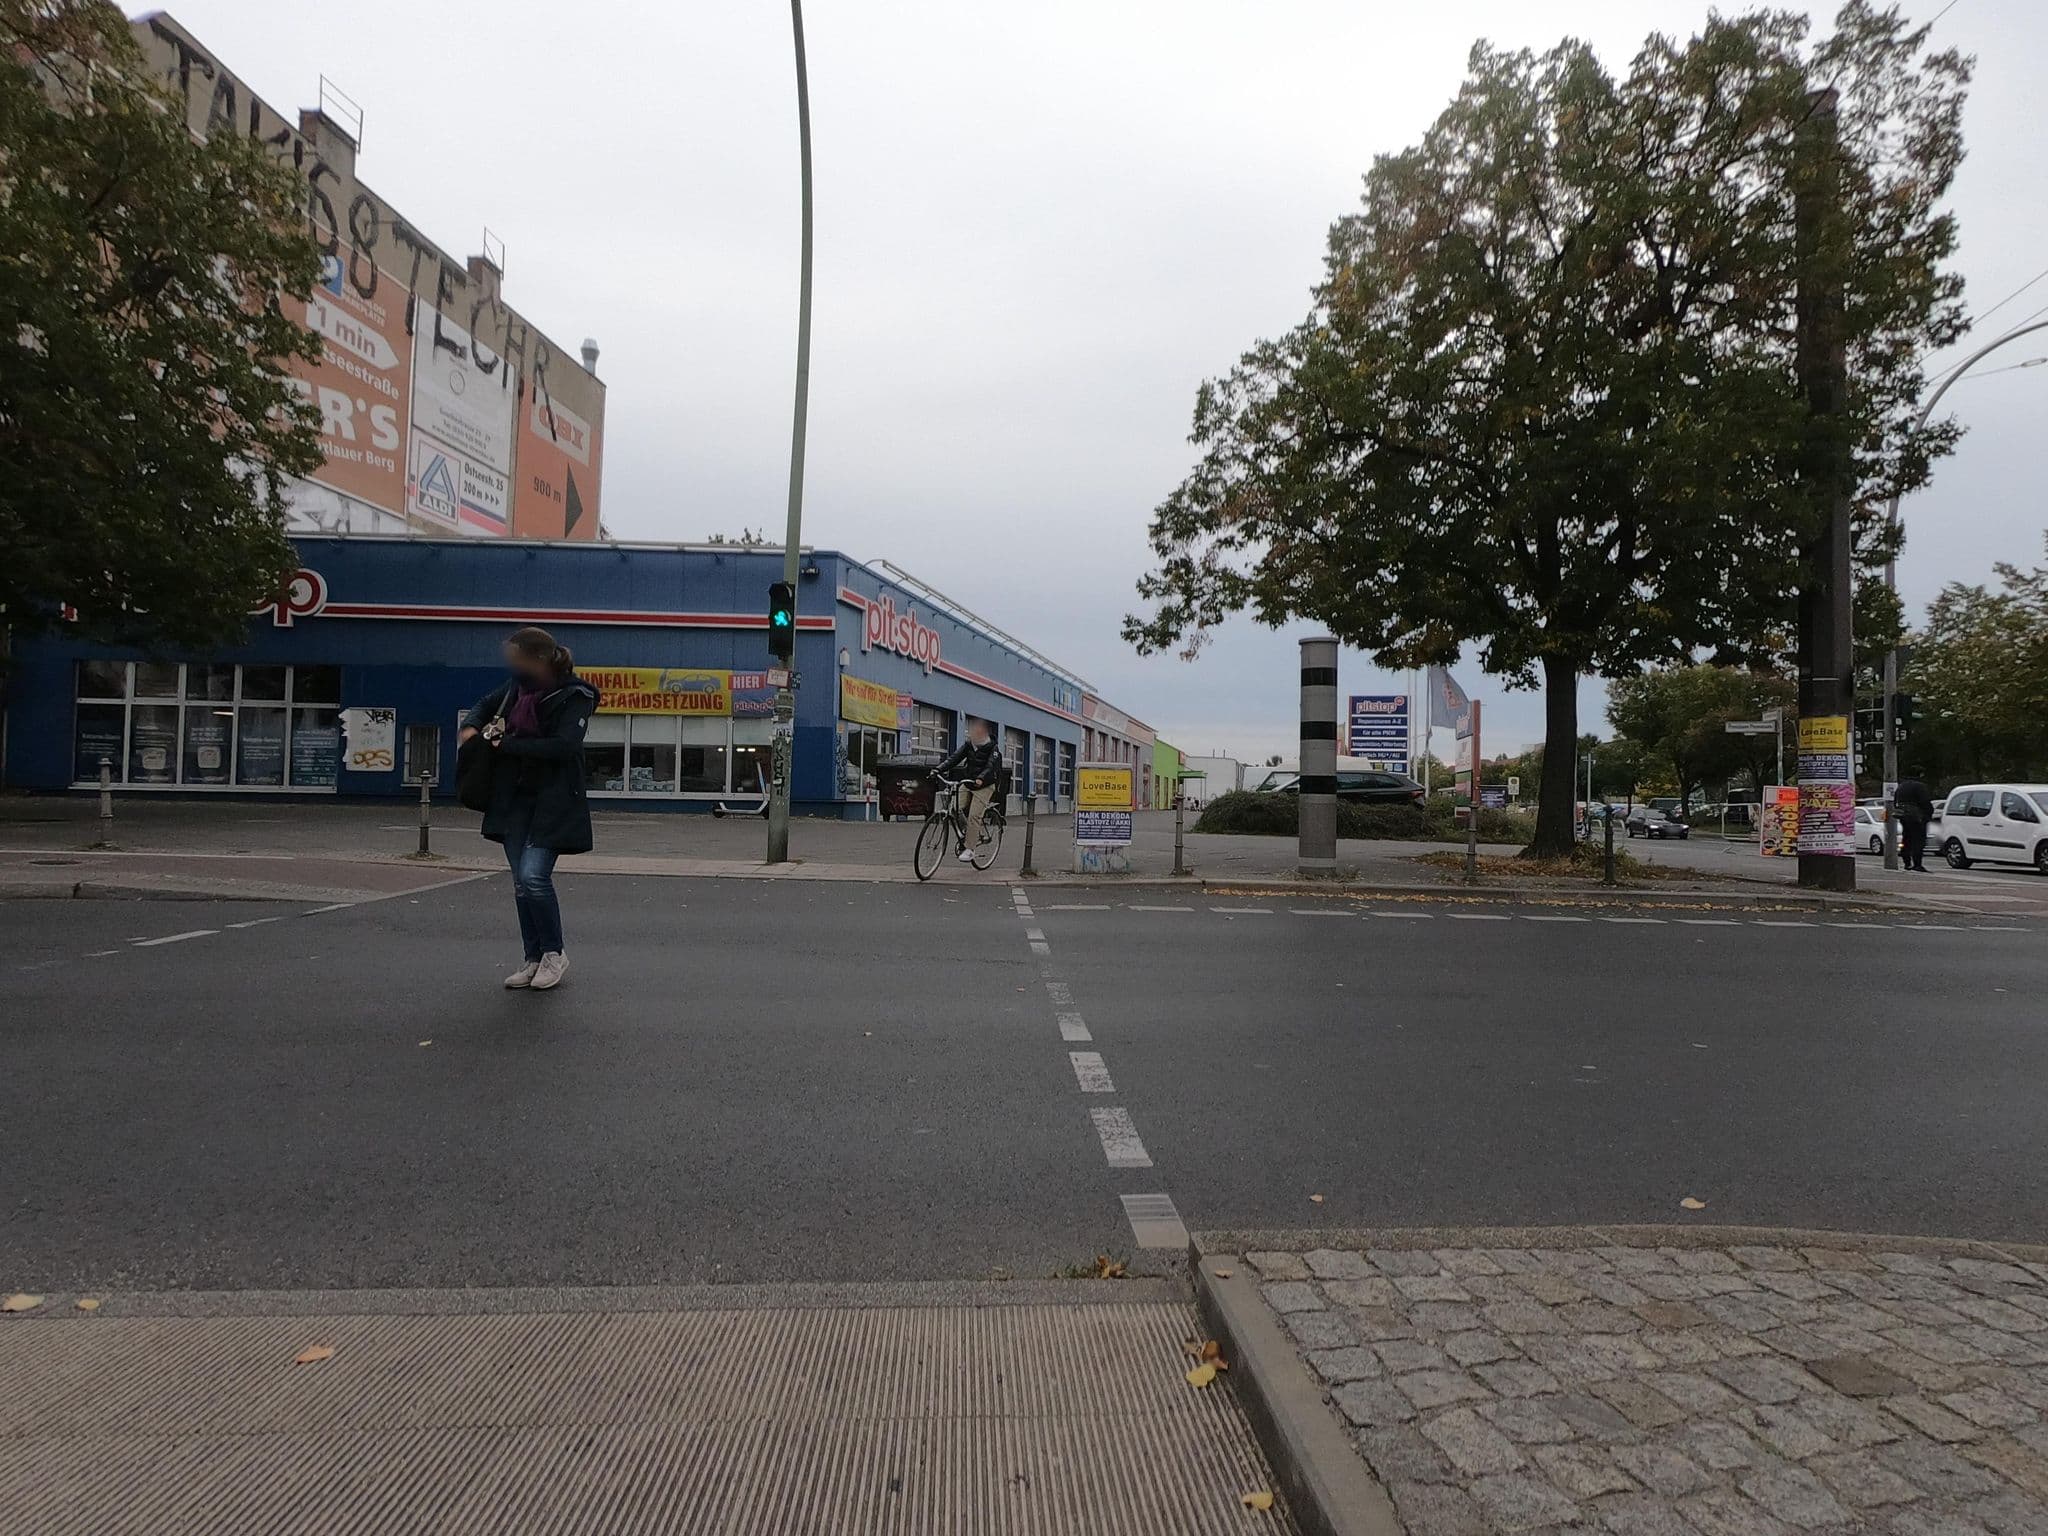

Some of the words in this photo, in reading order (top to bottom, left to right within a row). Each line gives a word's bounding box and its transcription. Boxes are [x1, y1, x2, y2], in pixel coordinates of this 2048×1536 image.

[317, 304, 328, 329] 1
[335, 319, 376, 359] min
[320, 343, 400, 400] tseestraße
[365, 450, 396, 474] Berg
[463, 480, 477, 496] 200
[552, 489, 562, 504] m
[421, 493, 454, 518] ALDI
[732, 674, 761, 689] HIER
[1356, 699, 1398, 714] pitstop
[1082, 781, 1127, 791] LoveBase
[1101, 812, 1130, 820] DEKODA
